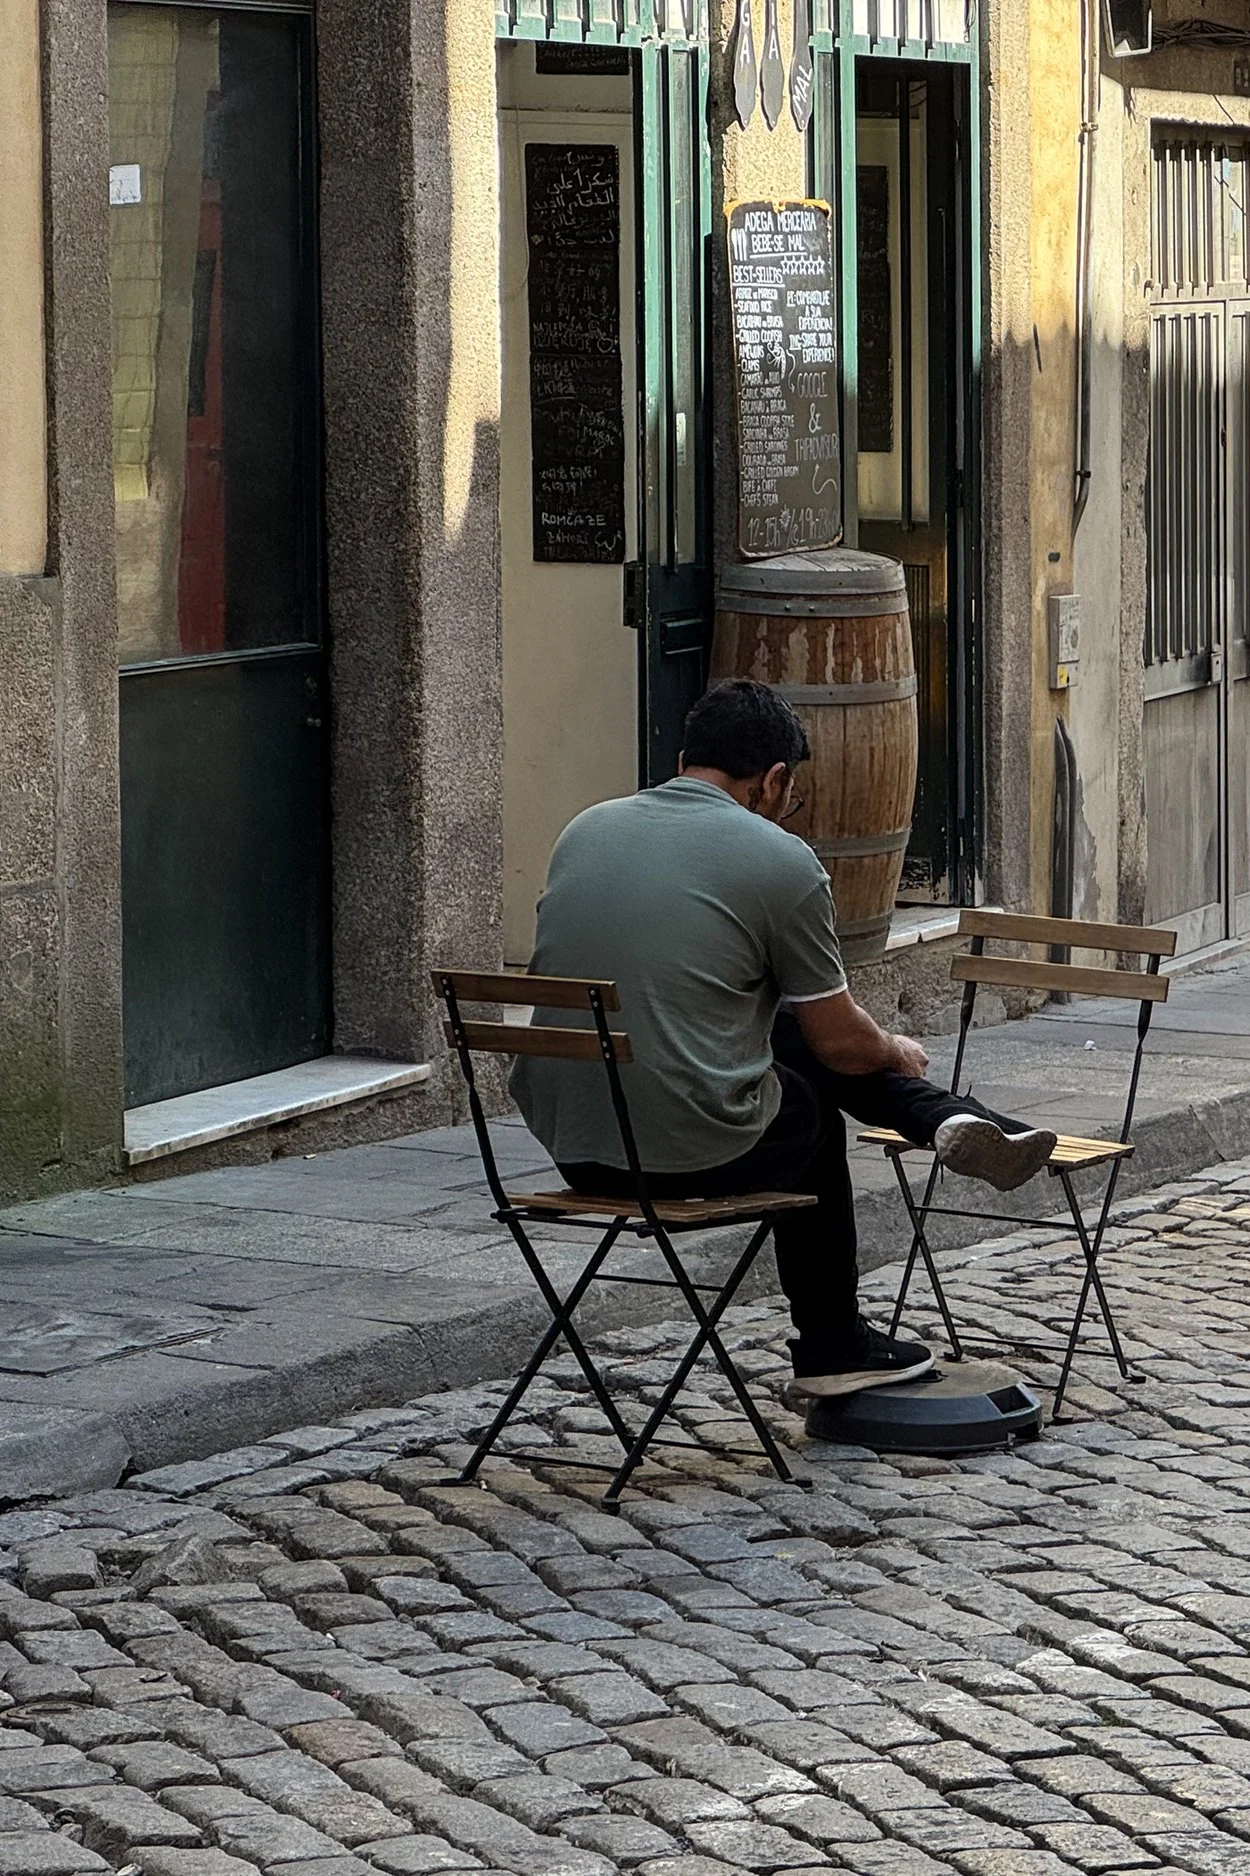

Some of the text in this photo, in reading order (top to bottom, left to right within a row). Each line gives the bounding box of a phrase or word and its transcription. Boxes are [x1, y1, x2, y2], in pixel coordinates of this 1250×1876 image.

[792, 64, 813, 116] MAL
[744, 210, 817, 232] ADEGA MERCEARIA
[751, 233, 806, 253] BEBE-SE MAL
[733, 265, 783, 284] BEST-SELLERS
[797, 371, 829, 399] GOOGLE
[808, 402, 823, 433] &
